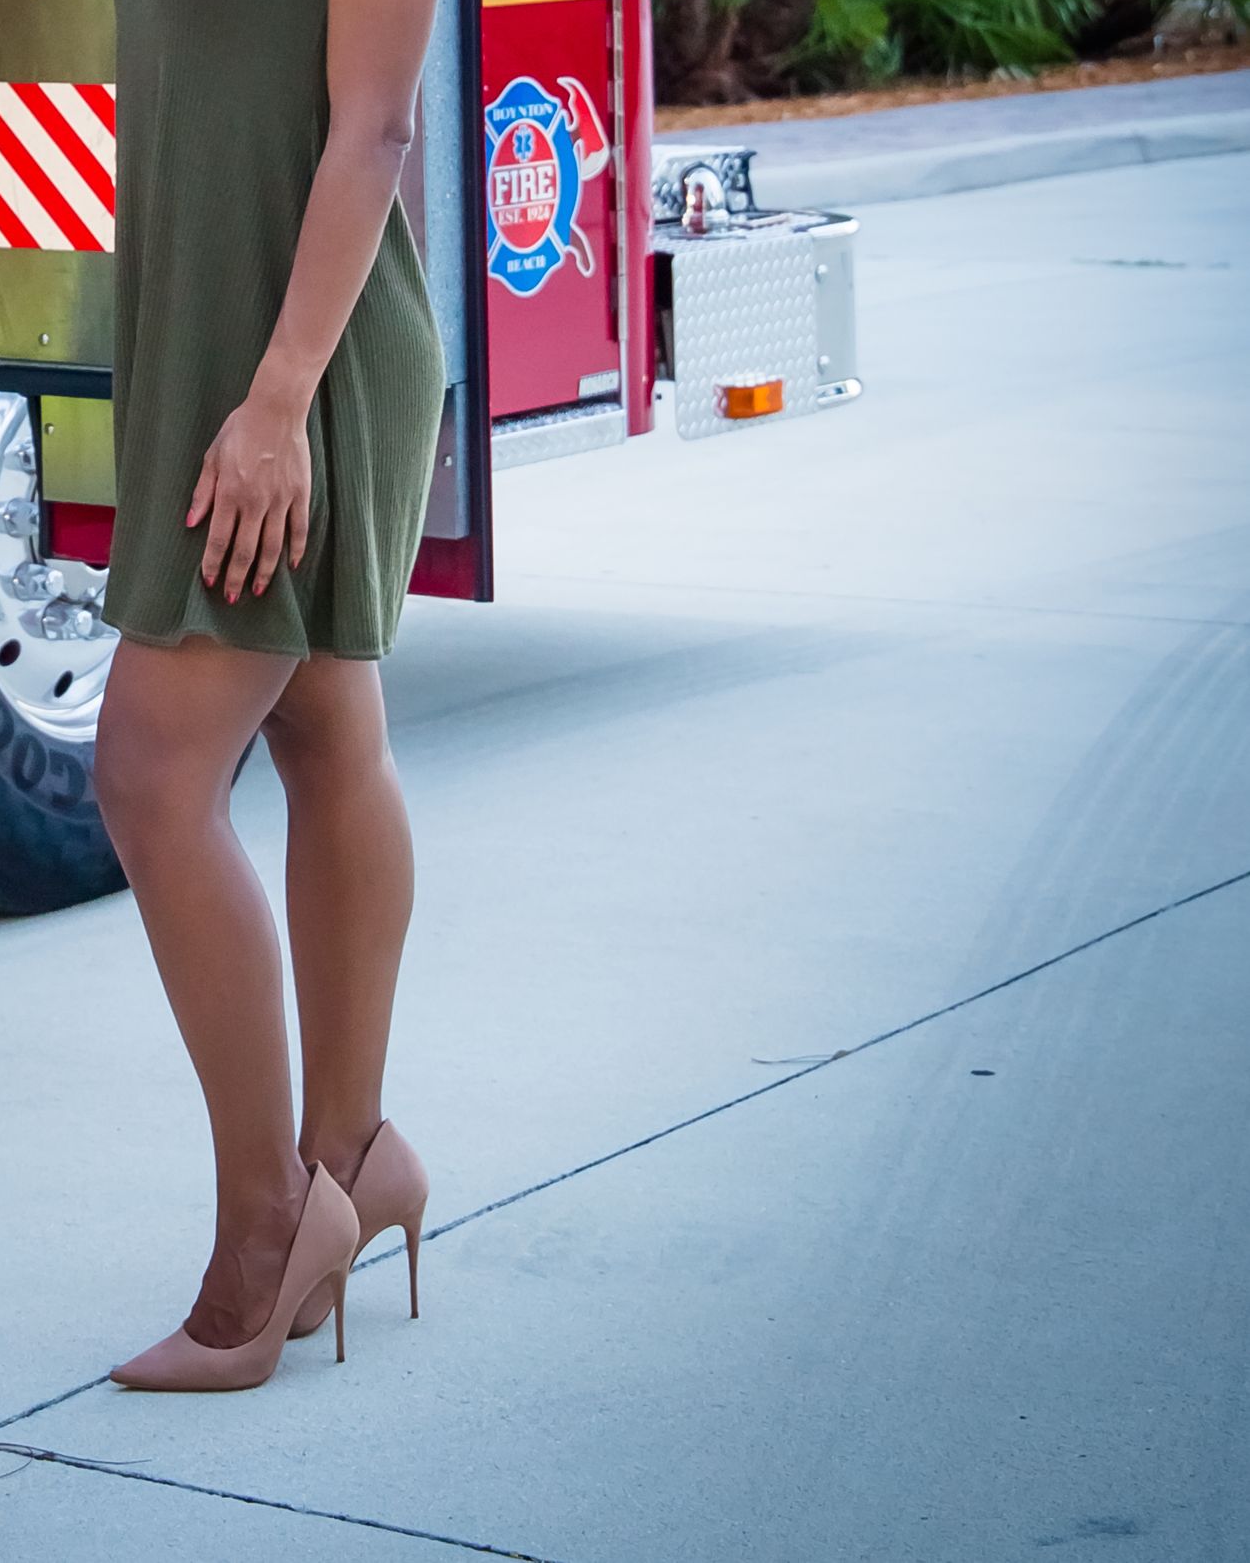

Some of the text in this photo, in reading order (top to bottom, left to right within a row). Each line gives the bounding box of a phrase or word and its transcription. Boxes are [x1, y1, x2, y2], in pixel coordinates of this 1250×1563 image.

[492, 102, 553, 122] BOYNTON
[494, 164, 554, 206] FIRE
[506, 254, 547, 274] BEACH
